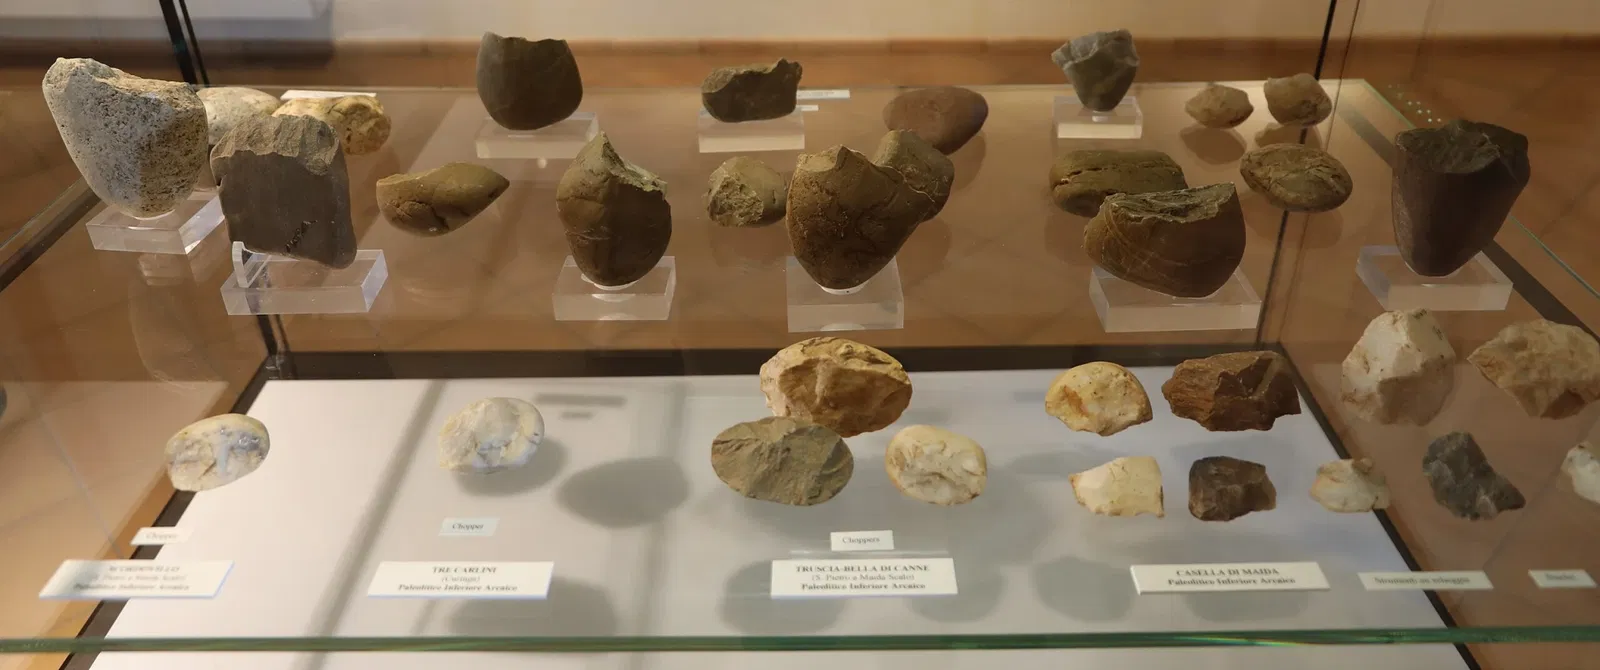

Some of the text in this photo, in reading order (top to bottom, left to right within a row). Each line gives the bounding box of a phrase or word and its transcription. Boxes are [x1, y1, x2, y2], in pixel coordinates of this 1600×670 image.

[452, 523, 484, 531] Chopper
[842, 536, 881, 545] Choppers
[432, 566, 497, 574] TRE CARLINI
[796, 565, 878, 573] TRUSCIA-BELLA
[894, 564, 930, 572] CANNE
[1176, 568, 1279, 577] CASELLA DI MAIDA
[1217, 577, 1257, 585] Inferiore
[1260, 577, 1296, 585] Arcaico
